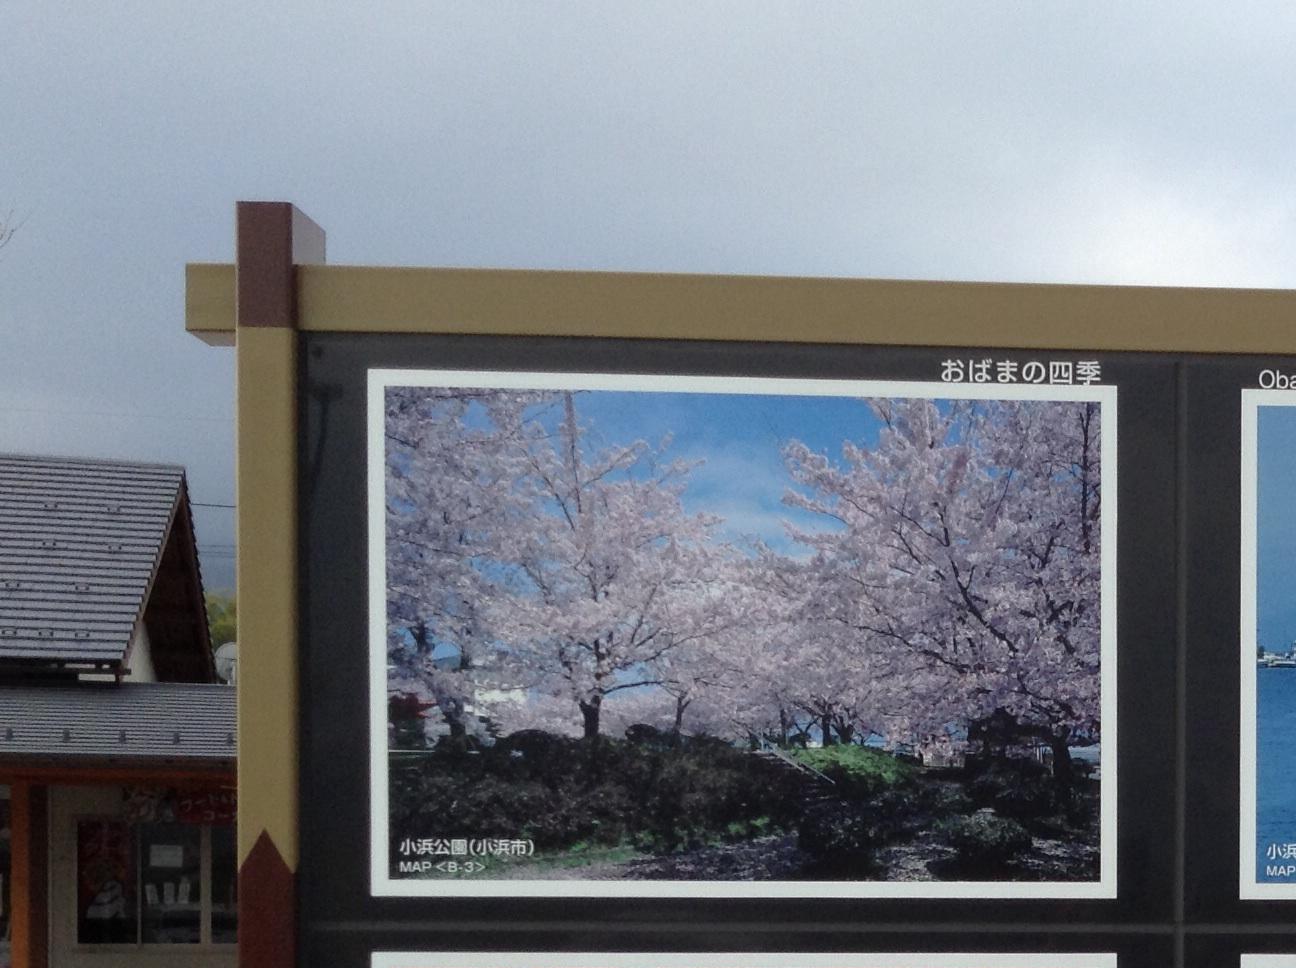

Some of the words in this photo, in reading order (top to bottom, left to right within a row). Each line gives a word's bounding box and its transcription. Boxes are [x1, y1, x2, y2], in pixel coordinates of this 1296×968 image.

[941, 359, 1101, 385] おばまの四季
[400, 838, 534, 856] 小浜公園(小浜市)
[400, 861, 432, 873] MAP
[1266, 865, 1296, 877] MAP
